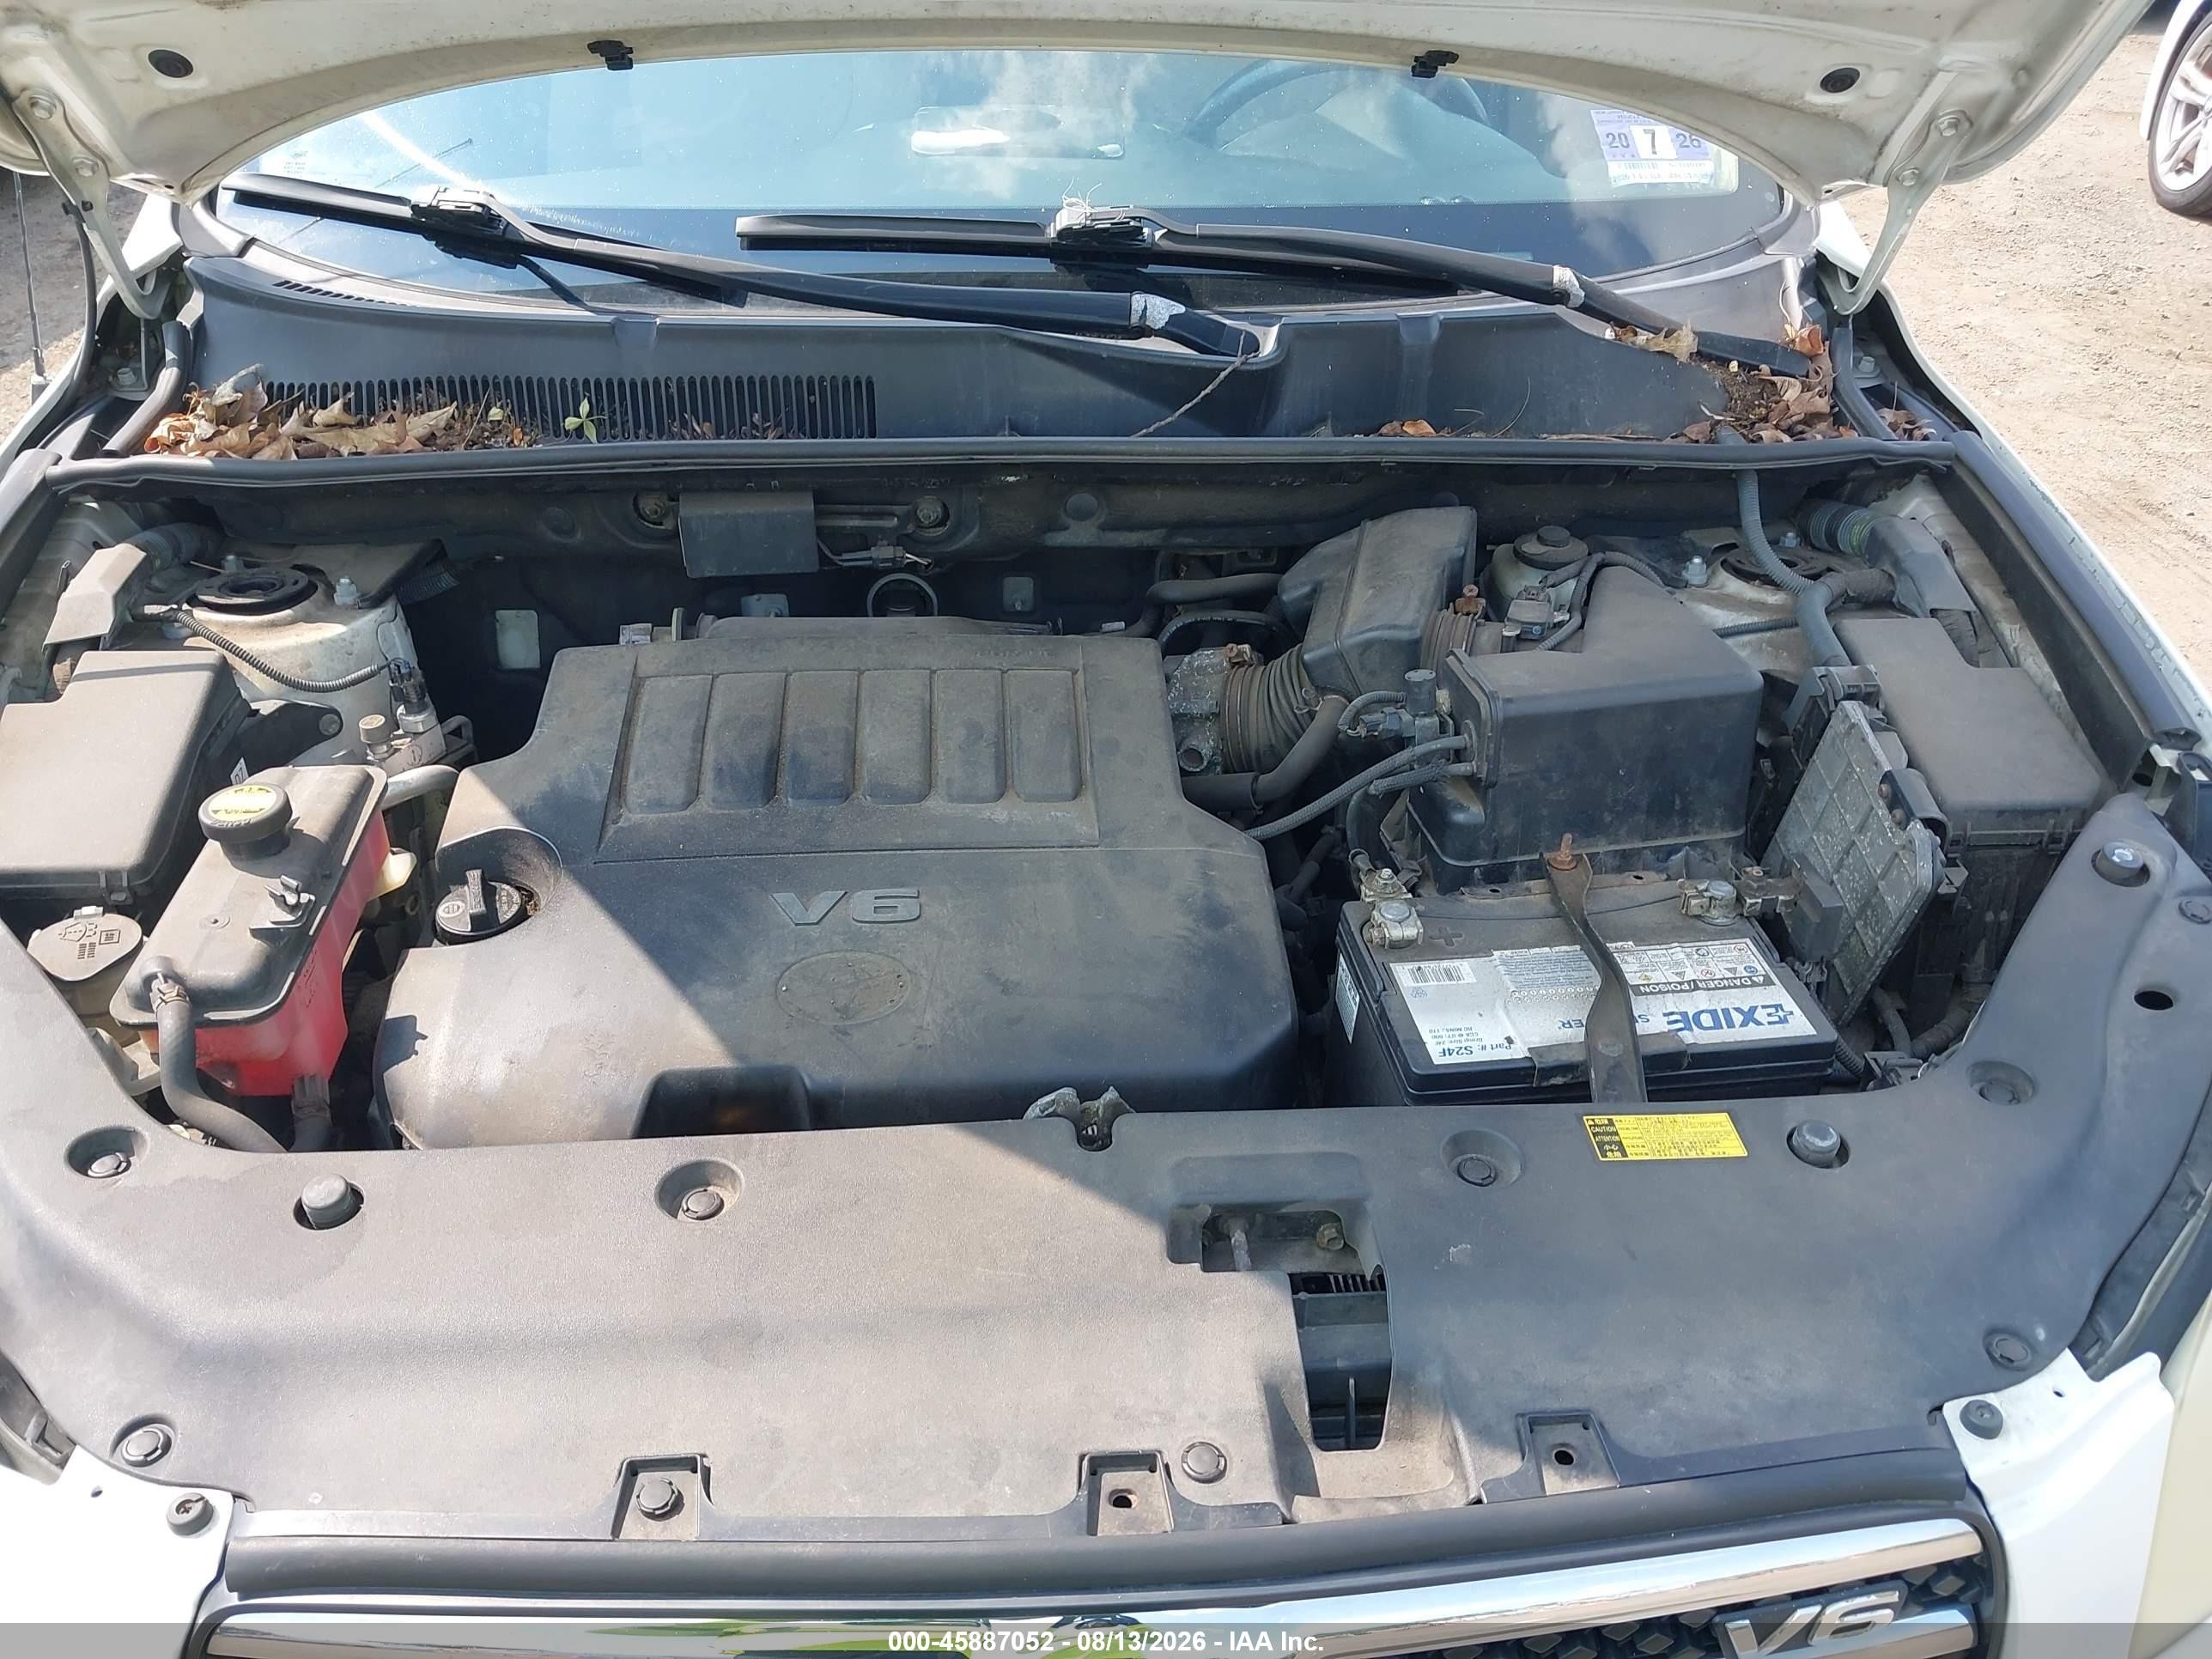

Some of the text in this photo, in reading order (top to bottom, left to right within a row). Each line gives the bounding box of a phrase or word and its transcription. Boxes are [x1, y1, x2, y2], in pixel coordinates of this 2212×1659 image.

[1606, 129, 1701, 155] 20 7 26
[769, 889, 921, 927] V6
[1639, 982, 1689, 993] POISON
[1697, 976, 1751, 990] DANGER
[1662, 1003, 1793, 1031] EXIDE
[1437, 1045, 1474, 1058] S24F
[1489, 1042, 1512, 1052] Part
[1724, 1590, 1899, 1658] V6
